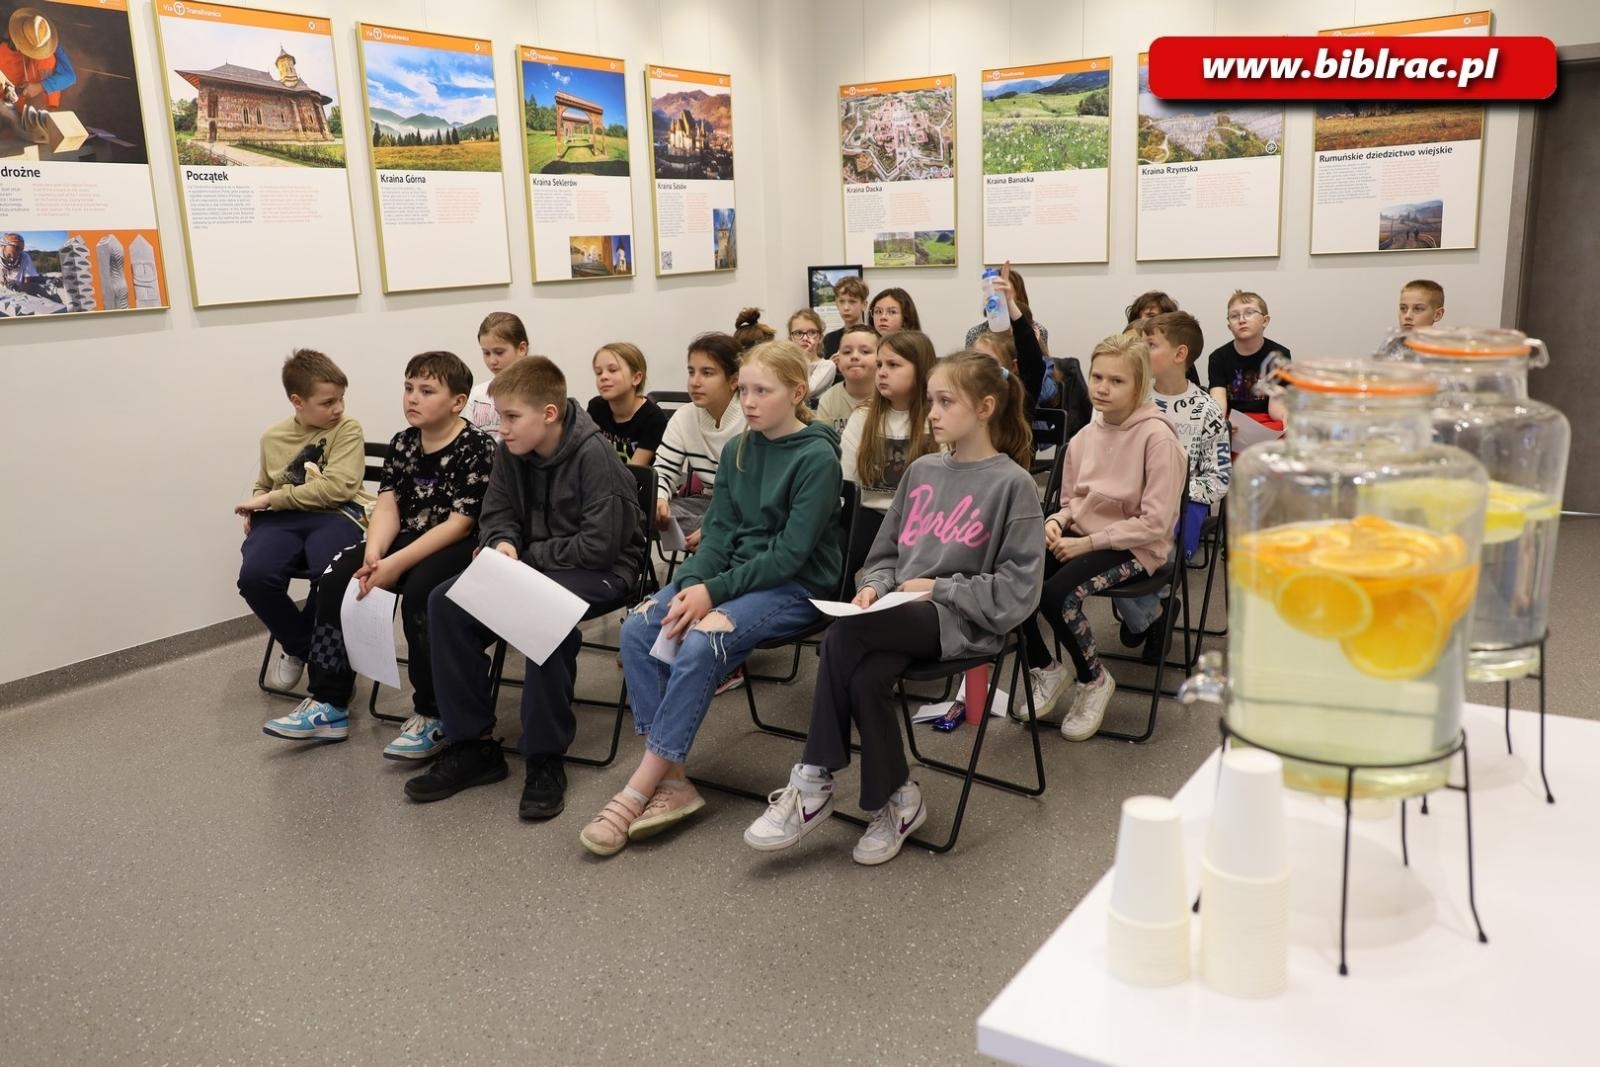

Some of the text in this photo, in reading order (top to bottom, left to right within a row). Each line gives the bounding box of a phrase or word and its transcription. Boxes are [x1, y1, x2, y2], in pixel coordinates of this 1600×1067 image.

[1319, 146, 1453, 162] Rumuńskie dziedzictwo wiejskie
[0, 166, 41, 178] drożne
[1166, 165, 1198, 175] Rzymska
[186, 170, 229, 183] Początek
[380, 174, 426, 183] Kraina Górna
[532, 178, 551, 186] Kraina
[899, 484, 990, 548] Barbie
